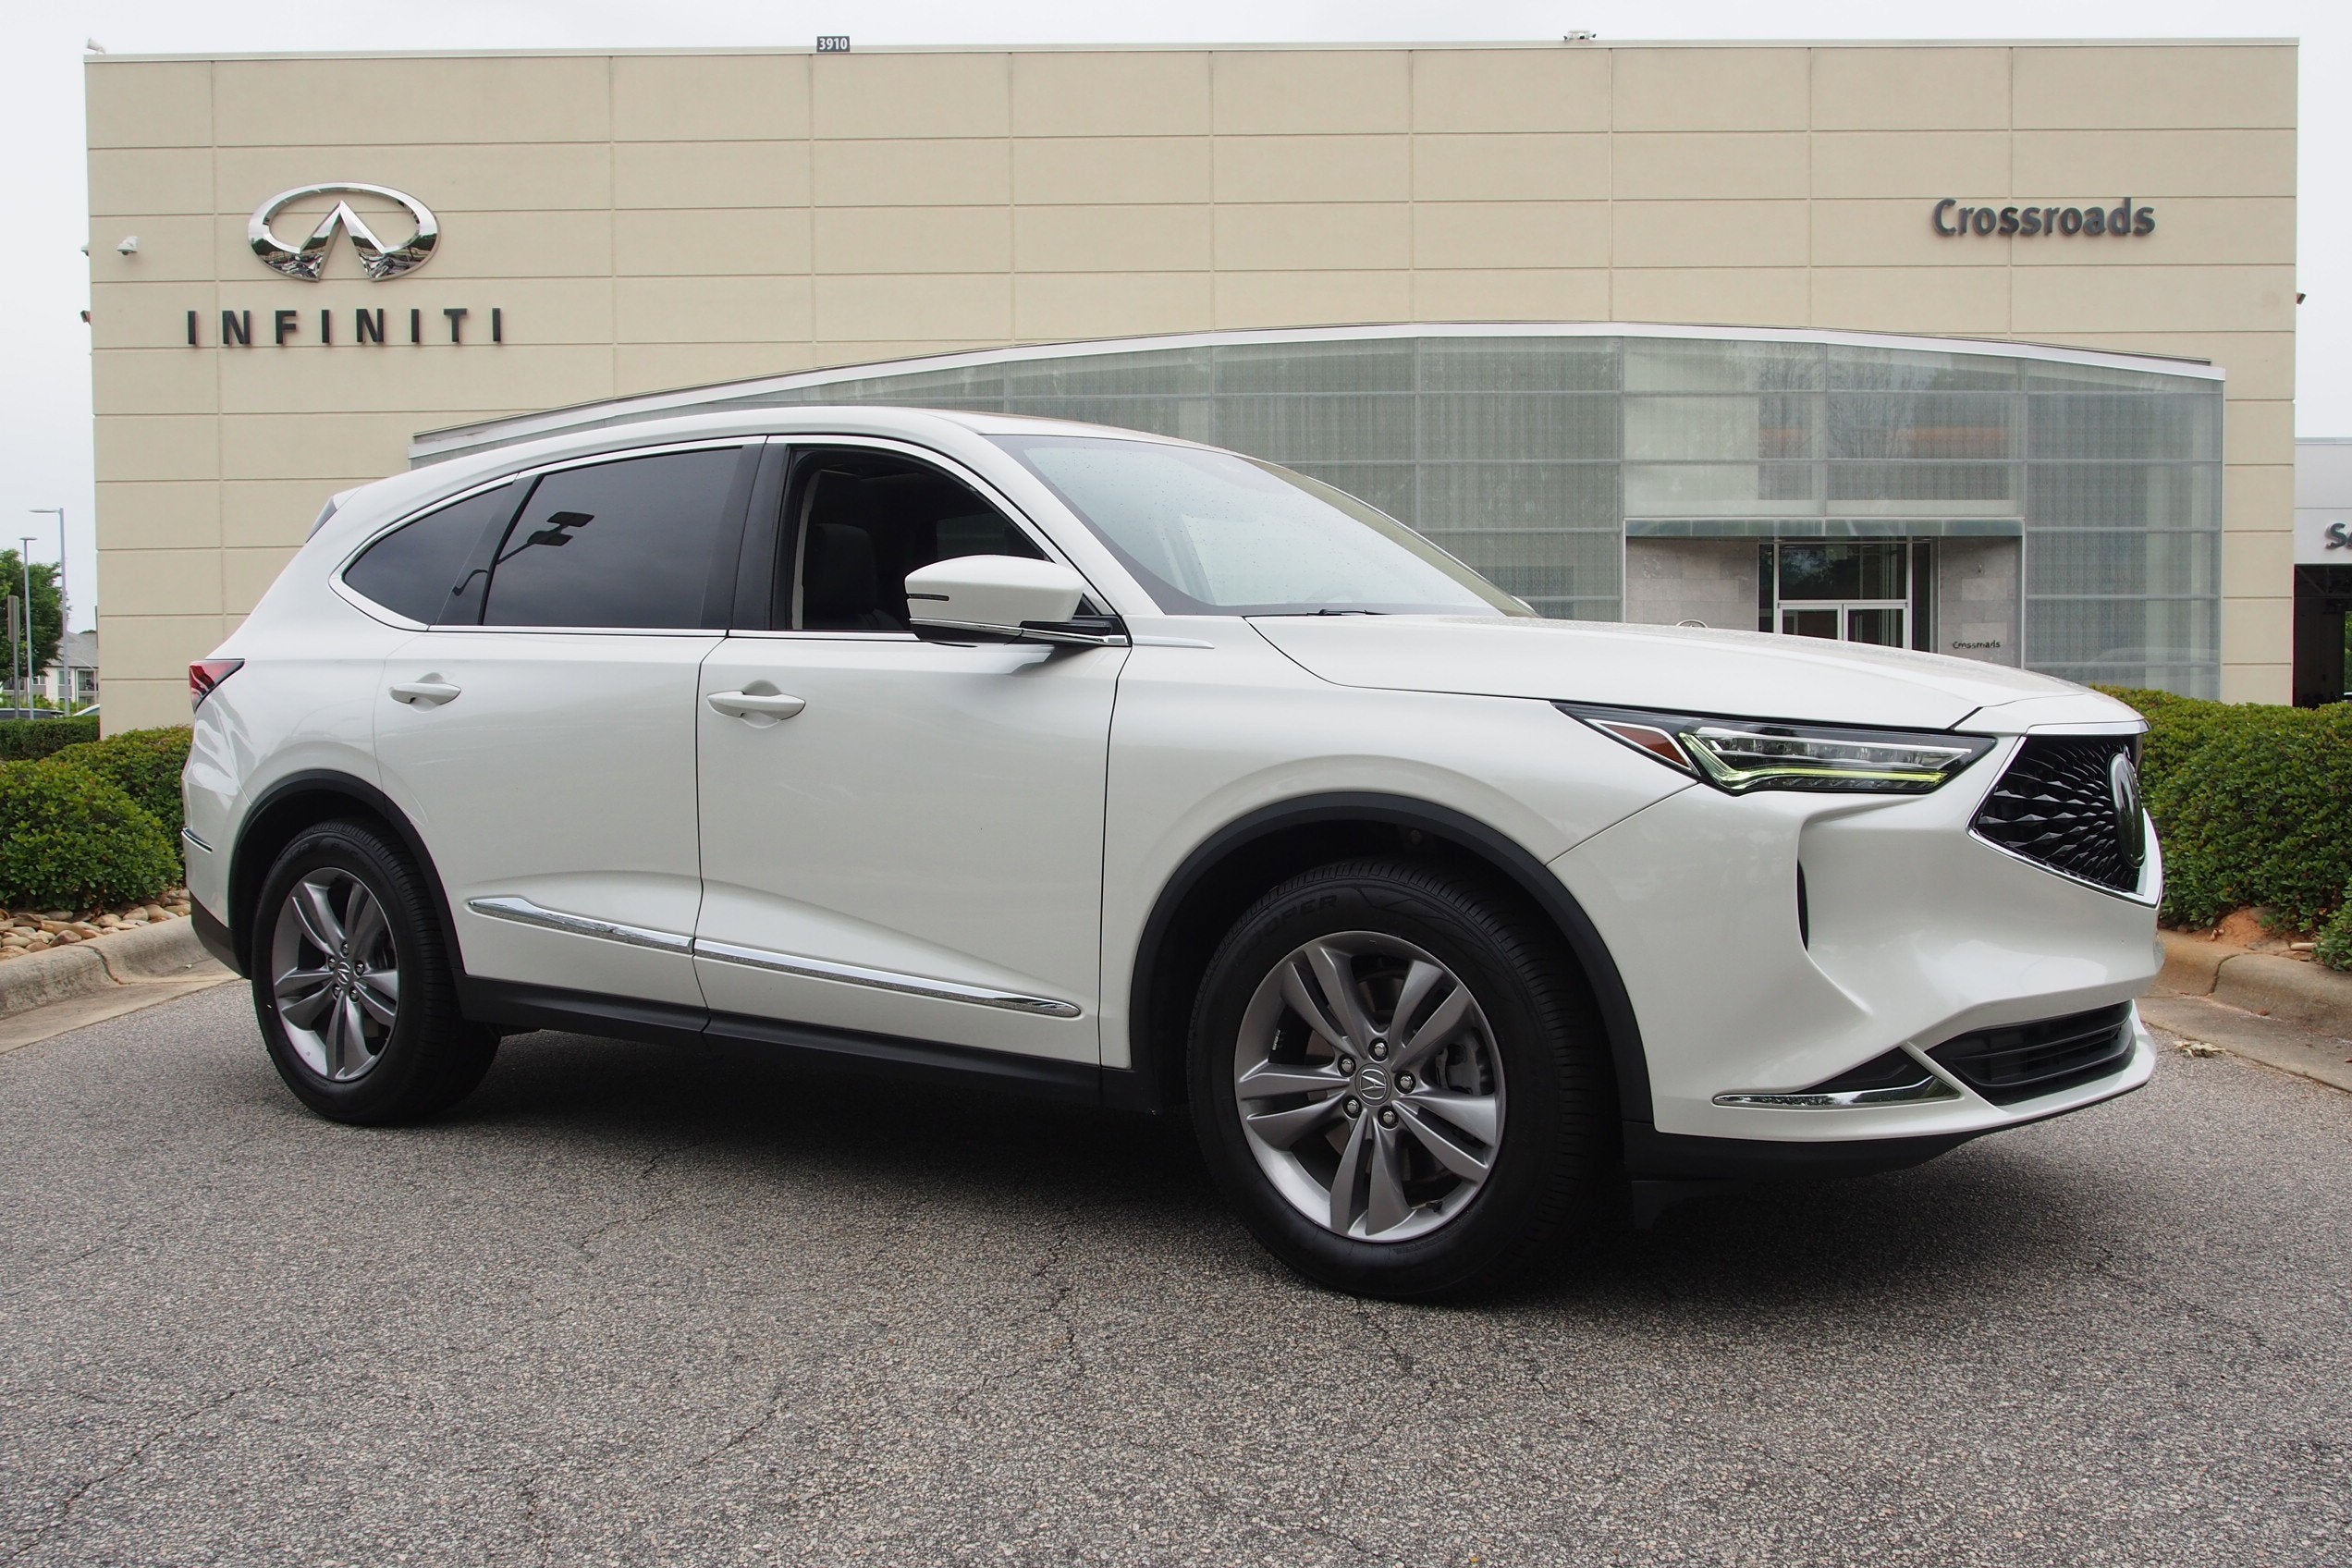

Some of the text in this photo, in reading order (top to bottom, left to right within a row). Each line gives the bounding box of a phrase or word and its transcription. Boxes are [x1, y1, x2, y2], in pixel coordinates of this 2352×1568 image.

[819, 38, 848, 50] 3910
[1933, 197, 2156, 236] Crossroads
[188, 308, 502, 346] INFINITI
[2324, 522, 2352, 550] S
